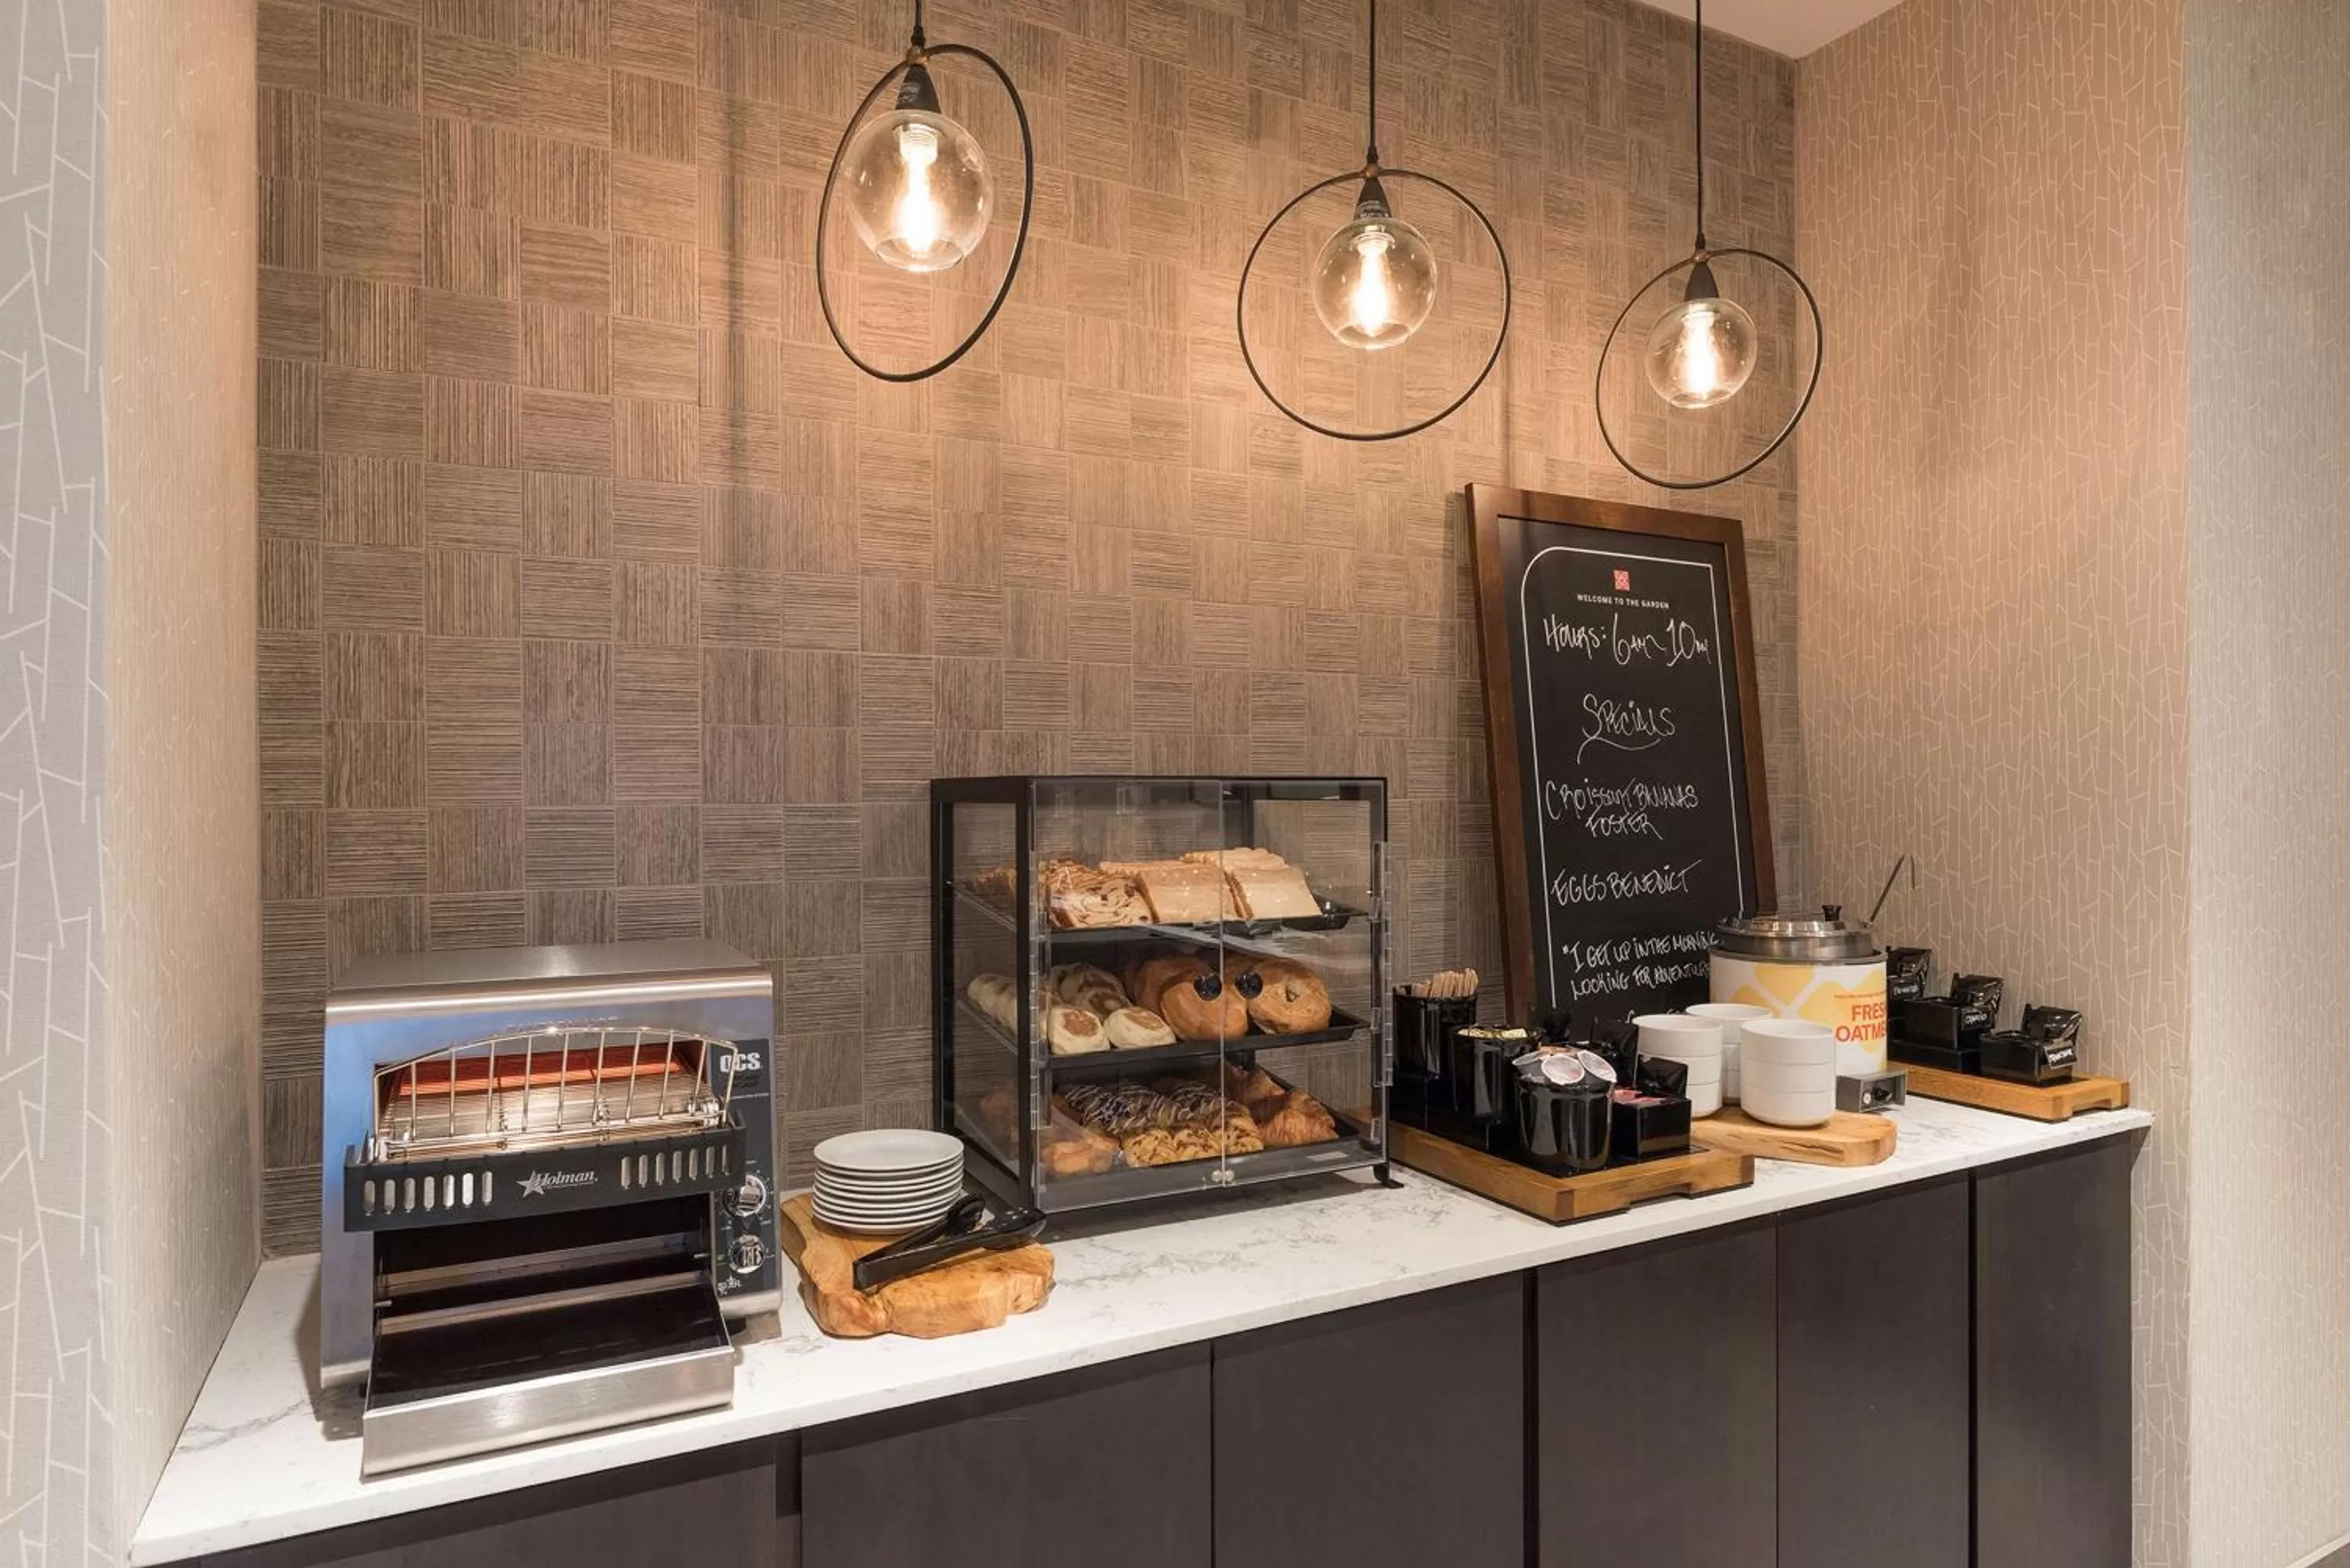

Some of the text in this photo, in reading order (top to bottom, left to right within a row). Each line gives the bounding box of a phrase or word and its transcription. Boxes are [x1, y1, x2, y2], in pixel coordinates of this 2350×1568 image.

[1577, 594, 1669, 609] WELCOME TO THE GARDEN
[1551, 869, 1606, 906] EGGS
[1586, 940, 1611, 968] GET
[1852, 1002, 1885, 1021] FRES
[1836, 1021, 1885, 1042] OATME
[536, 1171, 595, 1187] Holman
